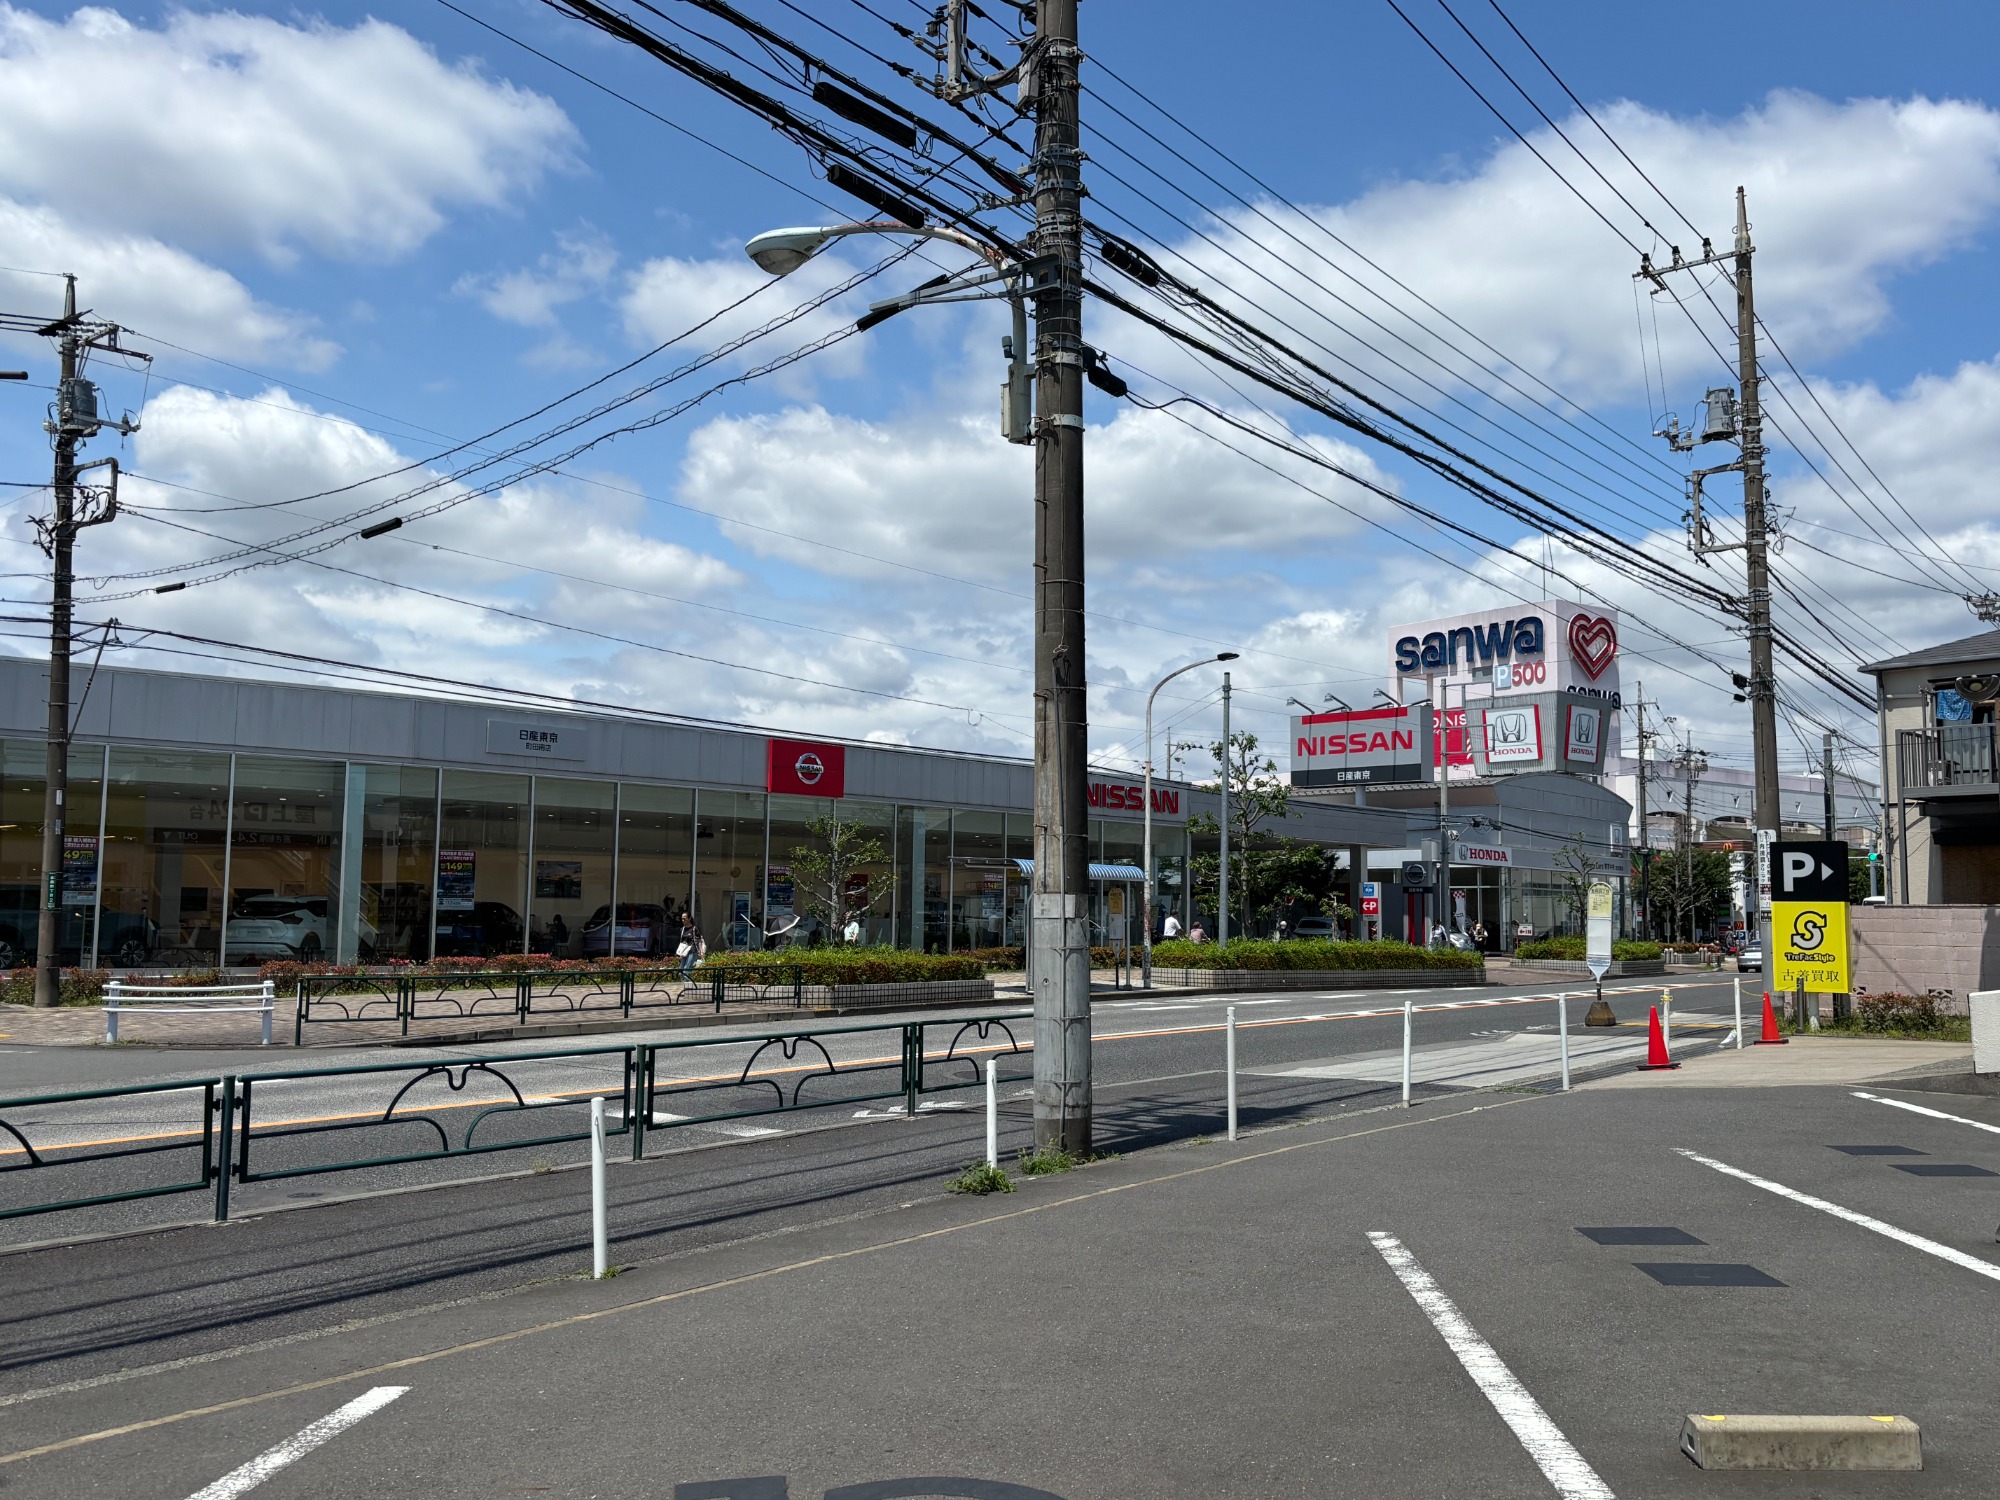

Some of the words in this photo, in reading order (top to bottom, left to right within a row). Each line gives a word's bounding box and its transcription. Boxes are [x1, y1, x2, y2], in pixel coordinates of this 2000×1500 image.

[1396, 616, 1544, 672] sanwa
[1512, 660, 1546, 686] 500
[519, 730, 558, 743] 日産東京
[1297, 730, 1412, 756] NISSAN
[1493, 747, 1533, 756] HONDA
[1571, 747, 1594, 756] HONDA
[799, 765, 823, 773] NISSAN
[1337, 770, 1371, 781] 日産東京
[1087, 783, 1179, 814] NISSAN
[1469, 848, 1508, 862] HONDA
[1782, 852, 1815, 892] P
[1369, 901, 1377, 911] P
[1784, 953, 1836, 963] TreFacStyle
[1782, 969, 1840, 983] 古着買取
